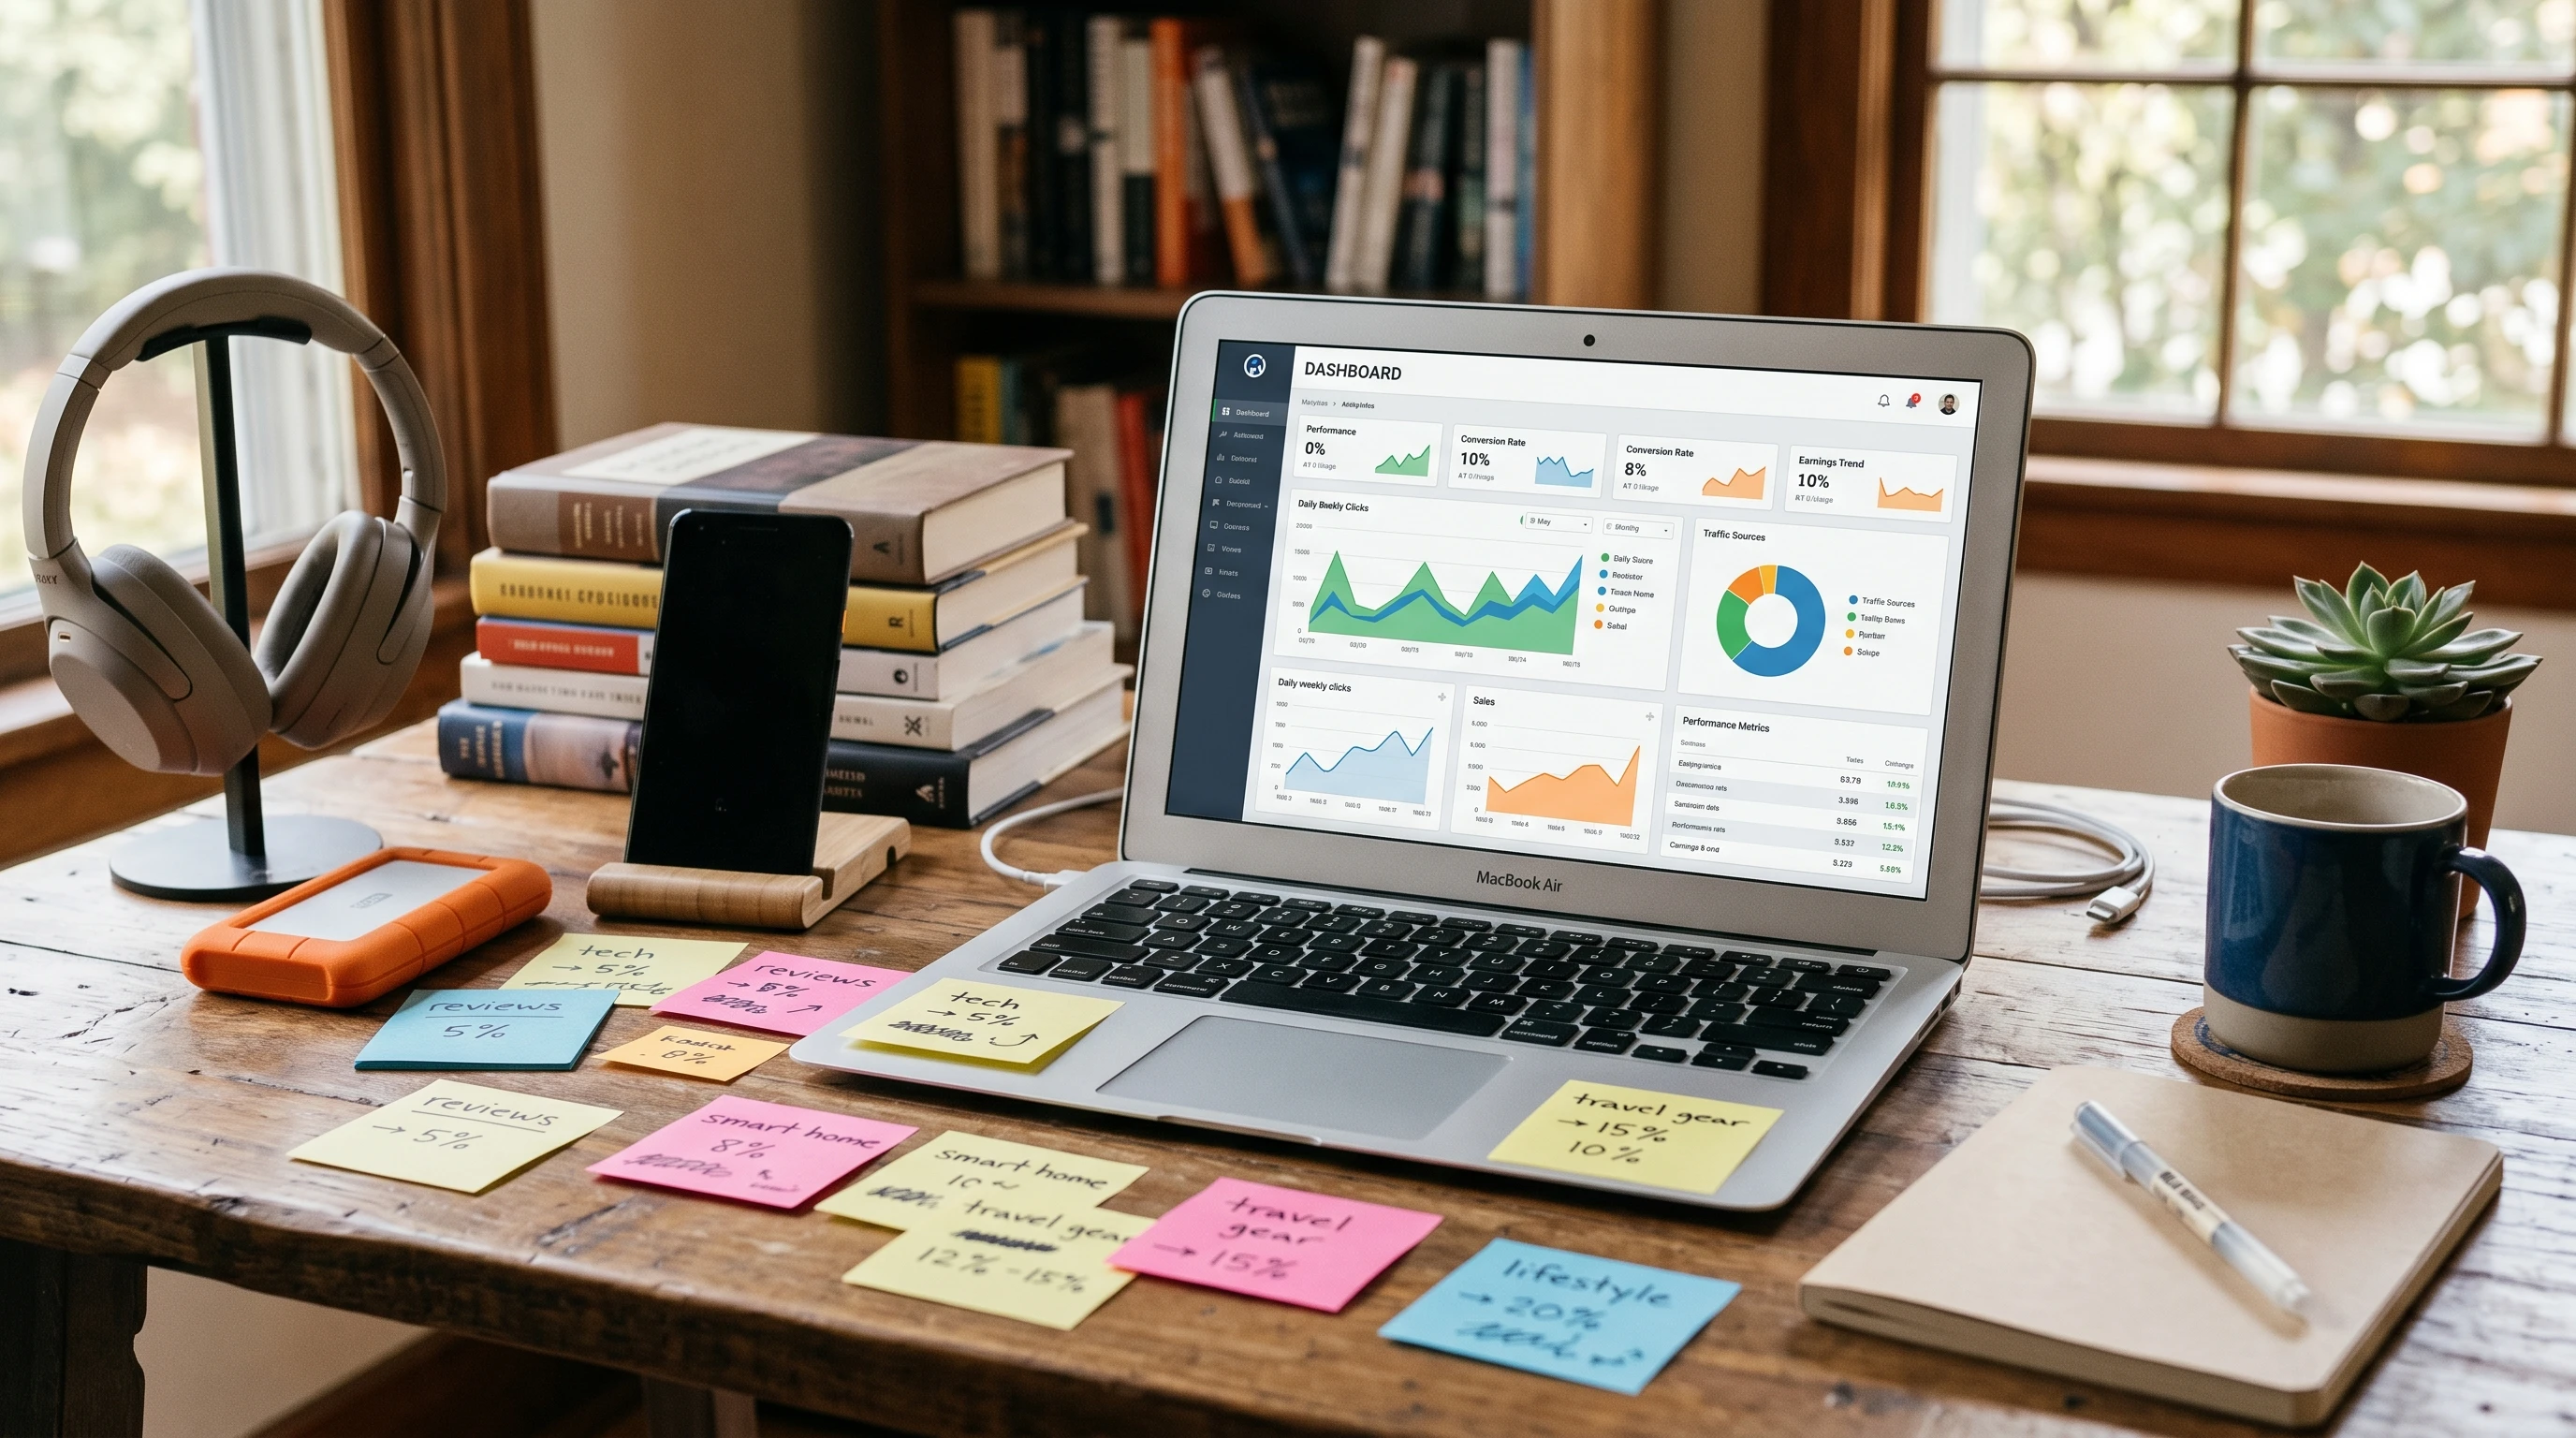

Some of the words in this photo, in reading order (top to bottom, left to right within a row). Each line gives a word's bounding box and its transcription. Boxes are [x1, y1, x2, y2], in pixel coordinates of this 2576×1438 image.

[1305, 361, 1402, 381] DASHBOARD
[1306, 424, 1356, 436] Performance
[1305, 441, 1326, 456] 0%
[1460, 434, 1506, 446] Conversion
[1507, 437, 1527, 447] Rate
[1460, 451, 1490, 466] 10%
[1626, 445, 1674, 456] Conversion
[1675, 448, 1694, 458] Rate
[1624, 462, 1647, 477] 8%
[1798, 455, 1837, 468] Earnings
[1838, 458, 1865, 468] Trend
[1797, 473, 1830, 489] 10%
[1297, 499, 1318, 510] Daily
[1345, 503, 1369, 512] Clicks
[1703, 528, 1731, 540] Traffic
[1732, 531, 1766, 542] Sources
[1886, 598, 1916, 609] Sources
[1278, 677, 1298, 689] Daily
[1299, 681, 1327, 692] weekly
[1328, 682, 1352, 693] clicks
[1472, 696, 1496, 706] Sales
[1682, 716, 1737, 730] Performance
[1738, 721, 1770, 733] Metrics
[1476, 870, 1541, 890] MacBook
[1543, 877, 1563, 893] Air
[578, 944, 656, 960] tech
[594, 963, 651, 977] 5%
[754, 963, 877, 989] reviews
[428, 1000, 564, 1013] reviews
[951, 990, 1020, 1010] tech
[966, 1011, 1021, 1027] 5%
[442, 1023, 510, 1039] 5%
[422, 1094, 561, 1127] reviews
[1573, 1093, 1667, 1117] travel
[1671, 1111, 1751, 1128] gear
[413, 1129, 483, 1151] 5%
[701, 1113, 800, 1135] smart
[803, 1125, 883, 1150] home
[1597, 1121, 1670, 1143] 15%
[710, 1137, 776, 1159] 8%
[1567, 1140, 1645, 1164] 10%
[934, 1148, 1031, 1172] smart
[1034, 1163, 1109, 1191] home
[963, 1198, 1062, 1229] travel
[1224, 1196, 1354, 1233] travel
[1218, 1223, 1325, 1245] gear
[915, 1246, 1001, 1277] 12%
[1208, 1250, 1299, 1281] 15%
[1500, 1258, 1674, 1308] lifestyle
[1503, 1295, 1608, 1331] 20%
